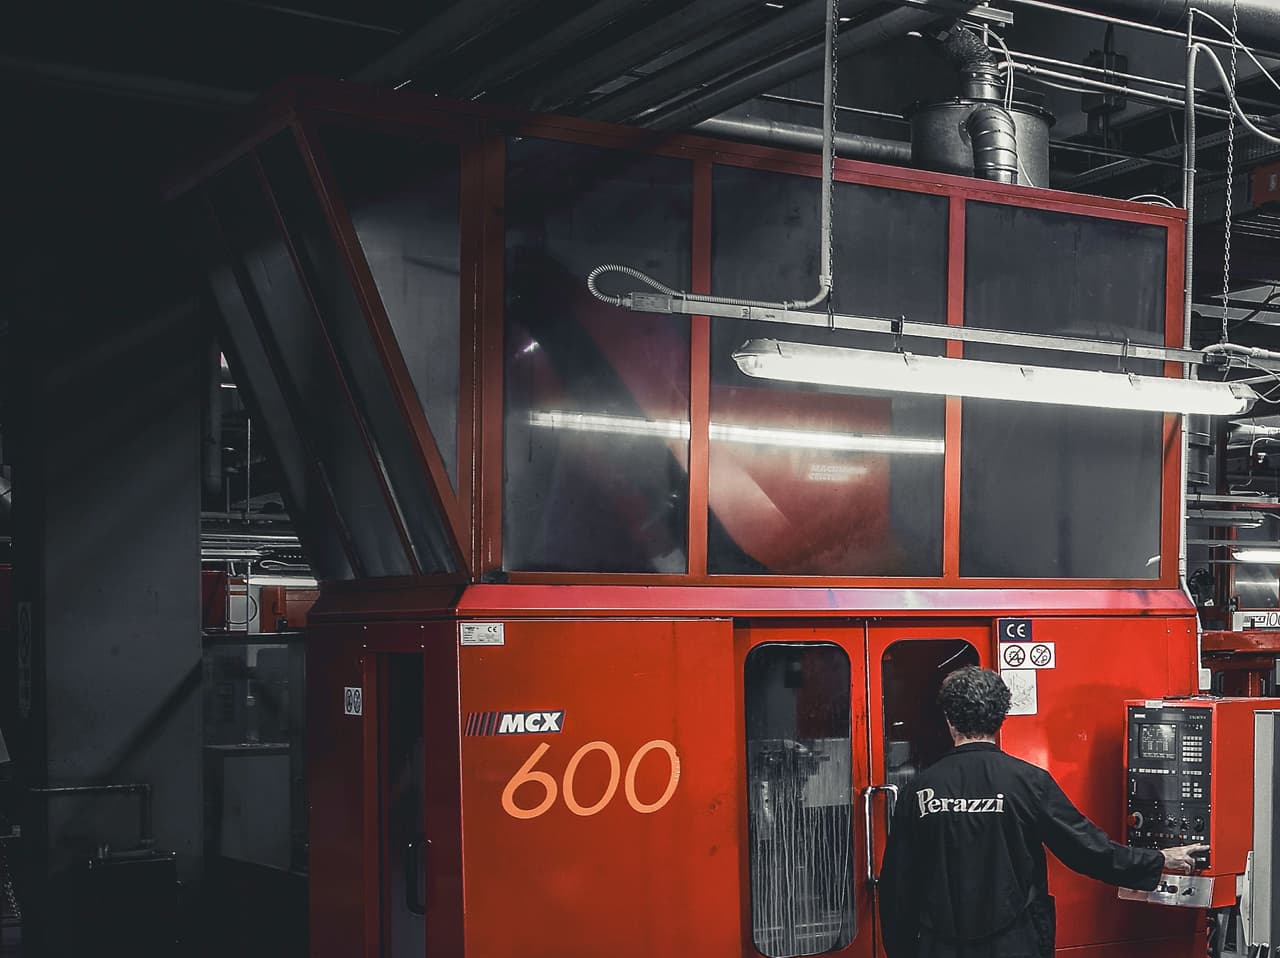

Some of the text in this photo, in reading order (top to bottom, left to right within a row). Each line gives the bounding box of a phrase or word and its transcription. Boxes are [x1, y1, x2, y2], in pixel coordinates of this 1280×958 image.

[1006, 623, 1026, 638] CE
[499, 711, 561, 733] MCX
[501, 739, 681, 820] 600
[916, 788, 1004, 818] Perazzi
